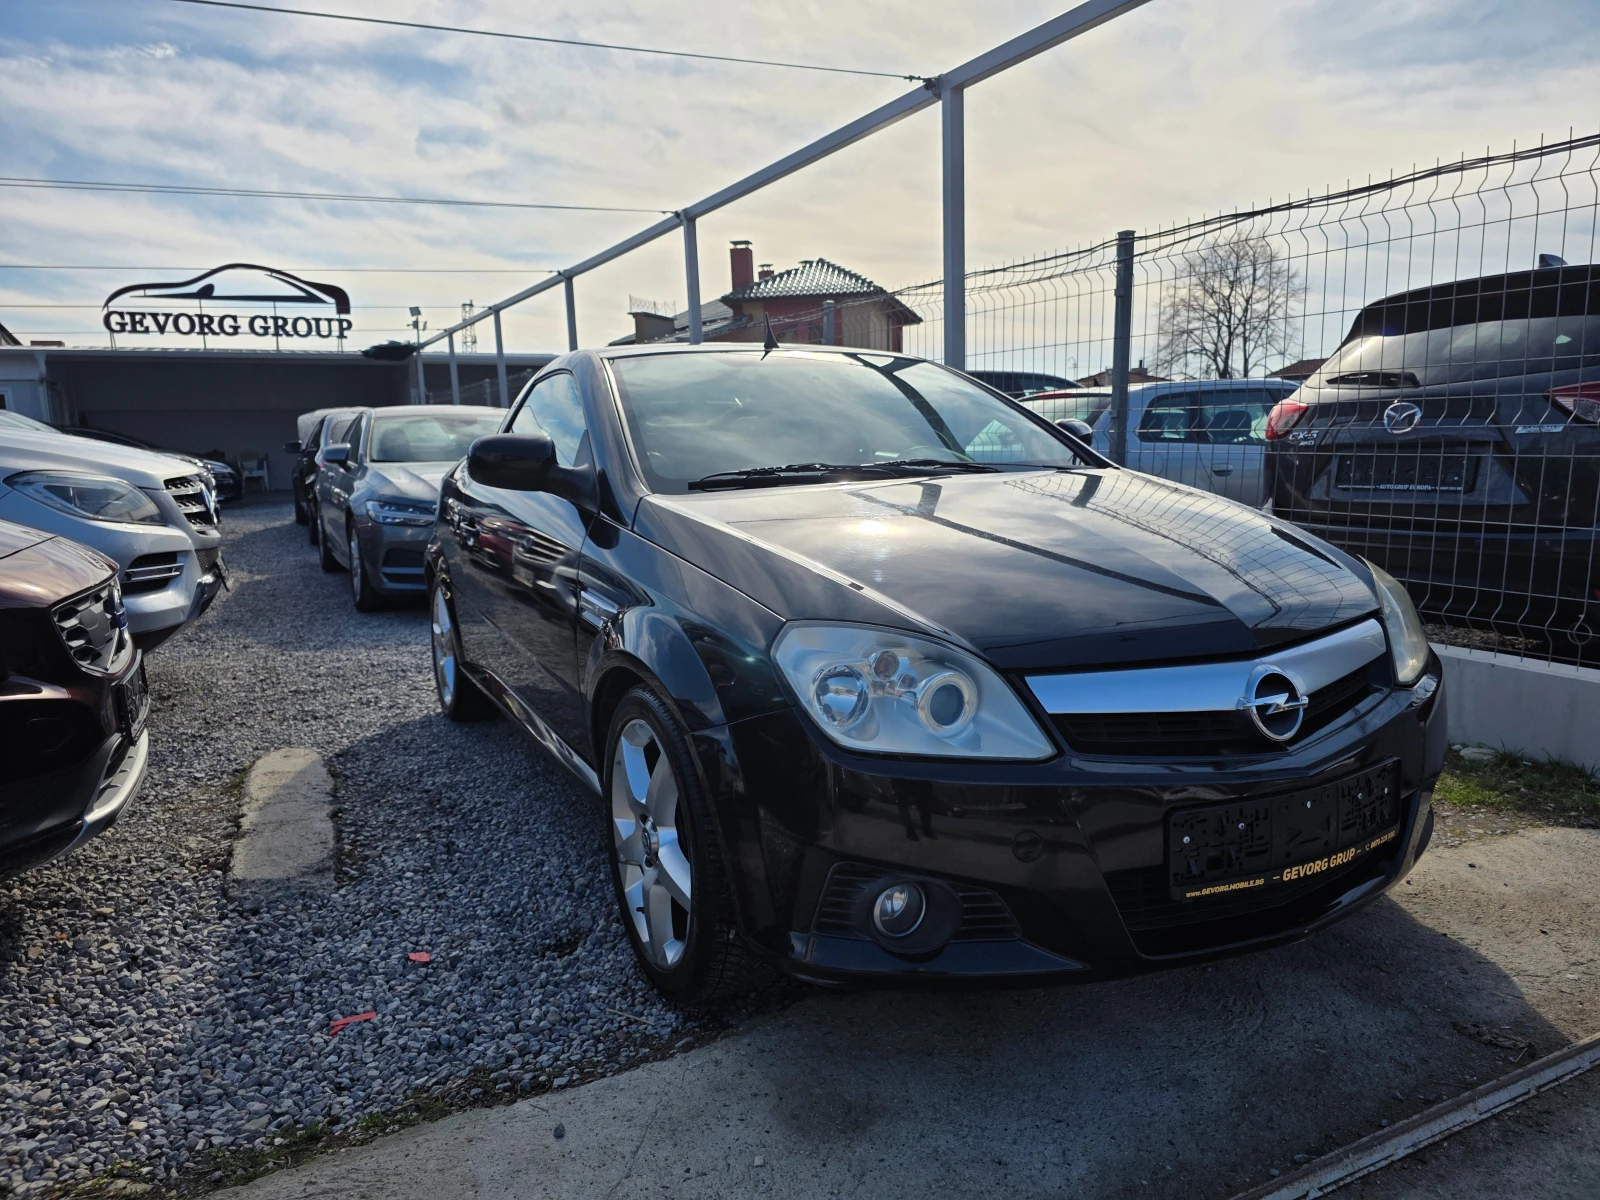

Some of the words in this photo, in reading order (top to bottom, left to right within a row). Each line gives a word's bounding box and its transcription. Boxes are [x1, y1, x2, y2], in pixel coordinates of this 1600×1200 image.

[103, 311, 241, 336] GEVORG
[248, 315, 353, 339] GROUP
[1282, 857, 1328, 882] GEVORG
[1329, 847, 1356, 868] GRUP
